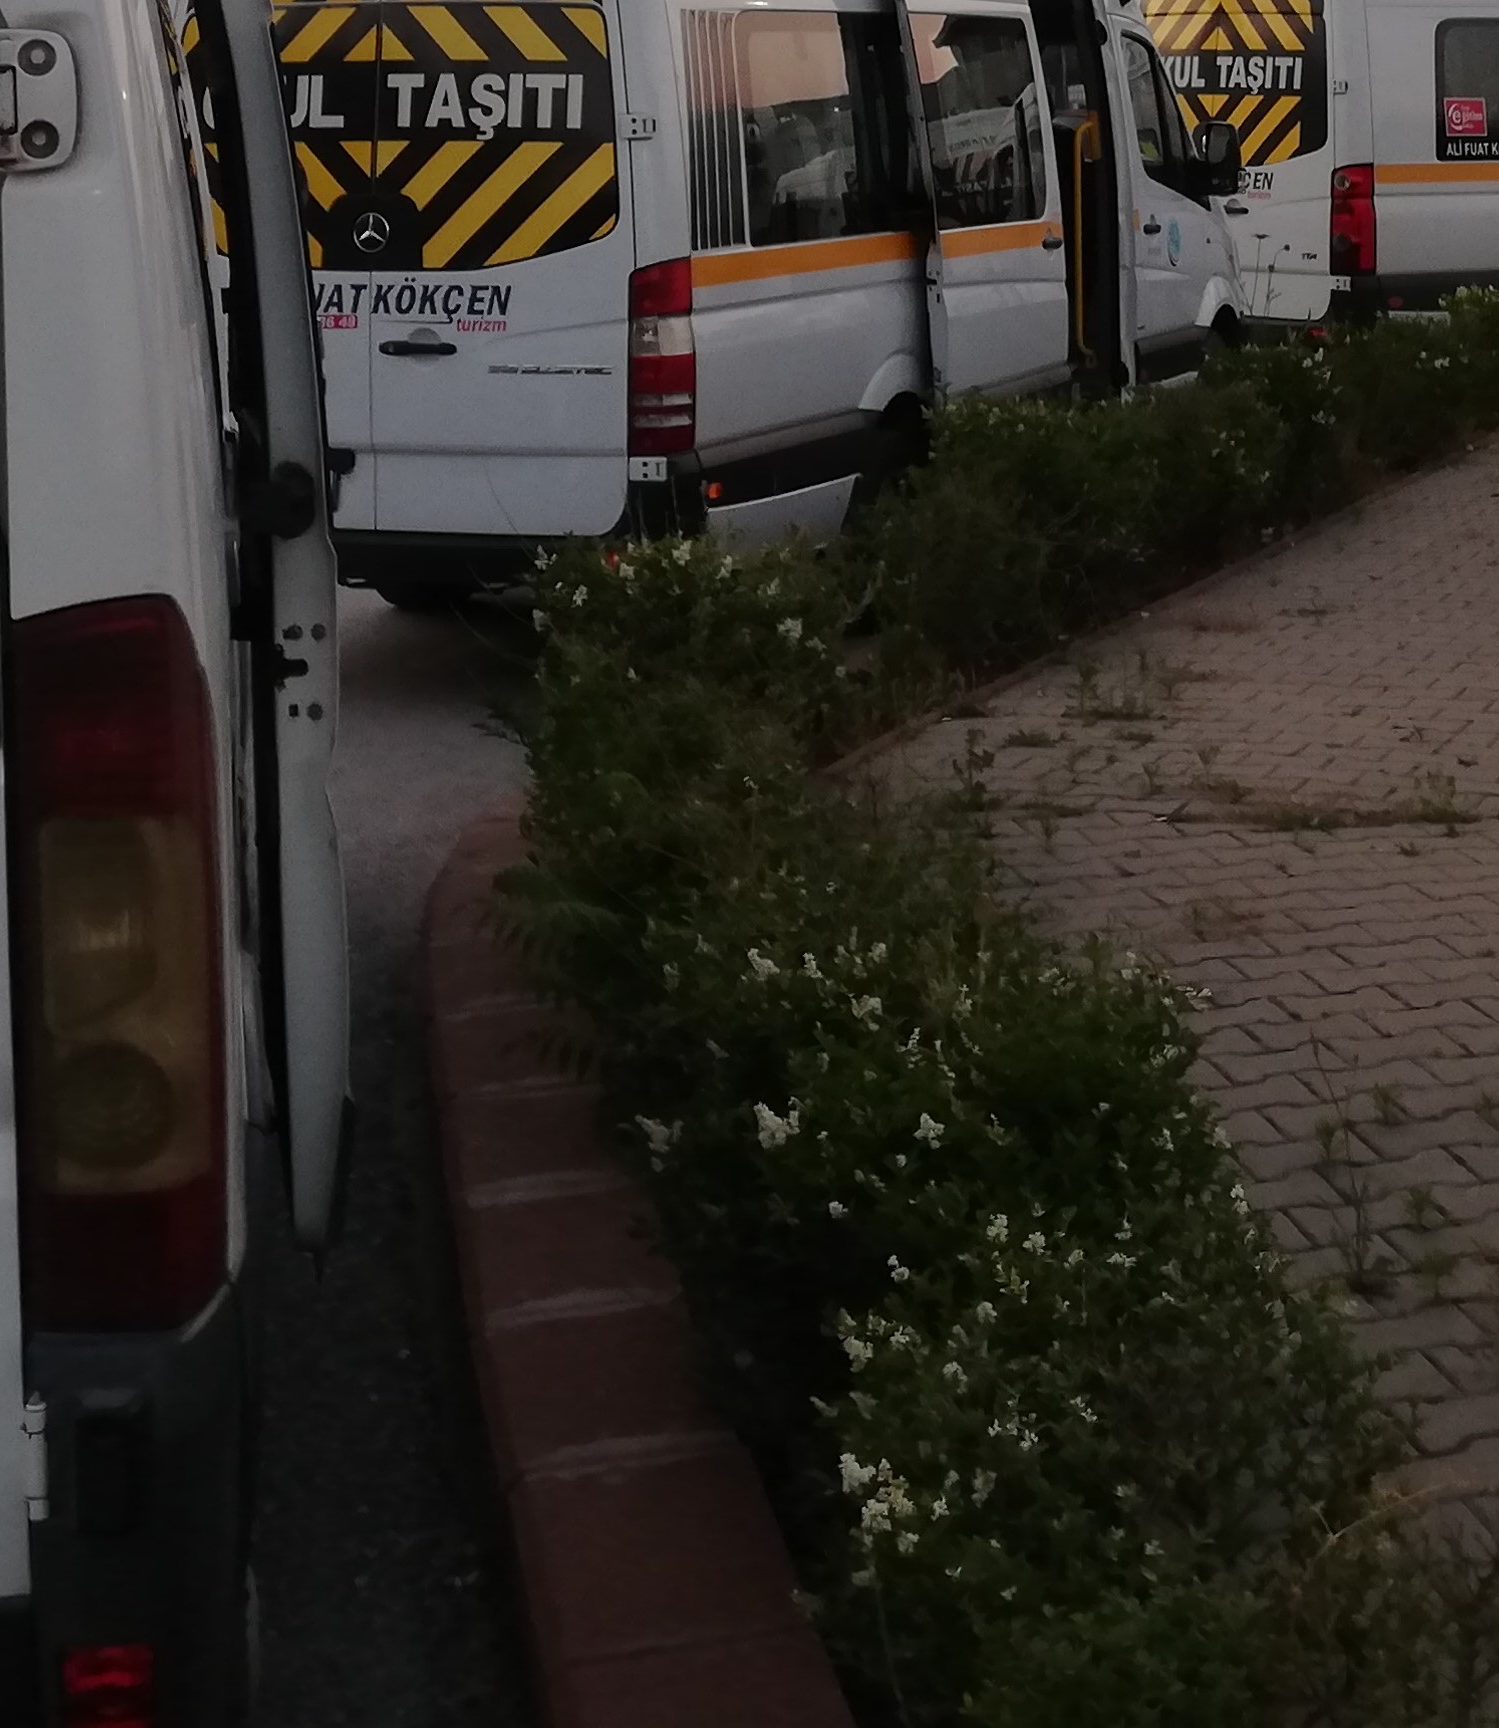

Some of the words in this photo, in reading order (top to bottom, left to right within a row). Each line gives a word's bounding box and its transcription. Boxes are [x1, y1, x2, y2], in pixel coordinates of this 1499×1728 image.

[1161, 55, 1205, 88] KUL
[1216, 56, 1303, 95] TAŞITI
[387, 73, 584, 141] TAŞITI
[1465, 142, 1488, 156] FUAT
[371, 277, 511, 324] KÖKÇEN
[457, 318, 506, 332] turizm
